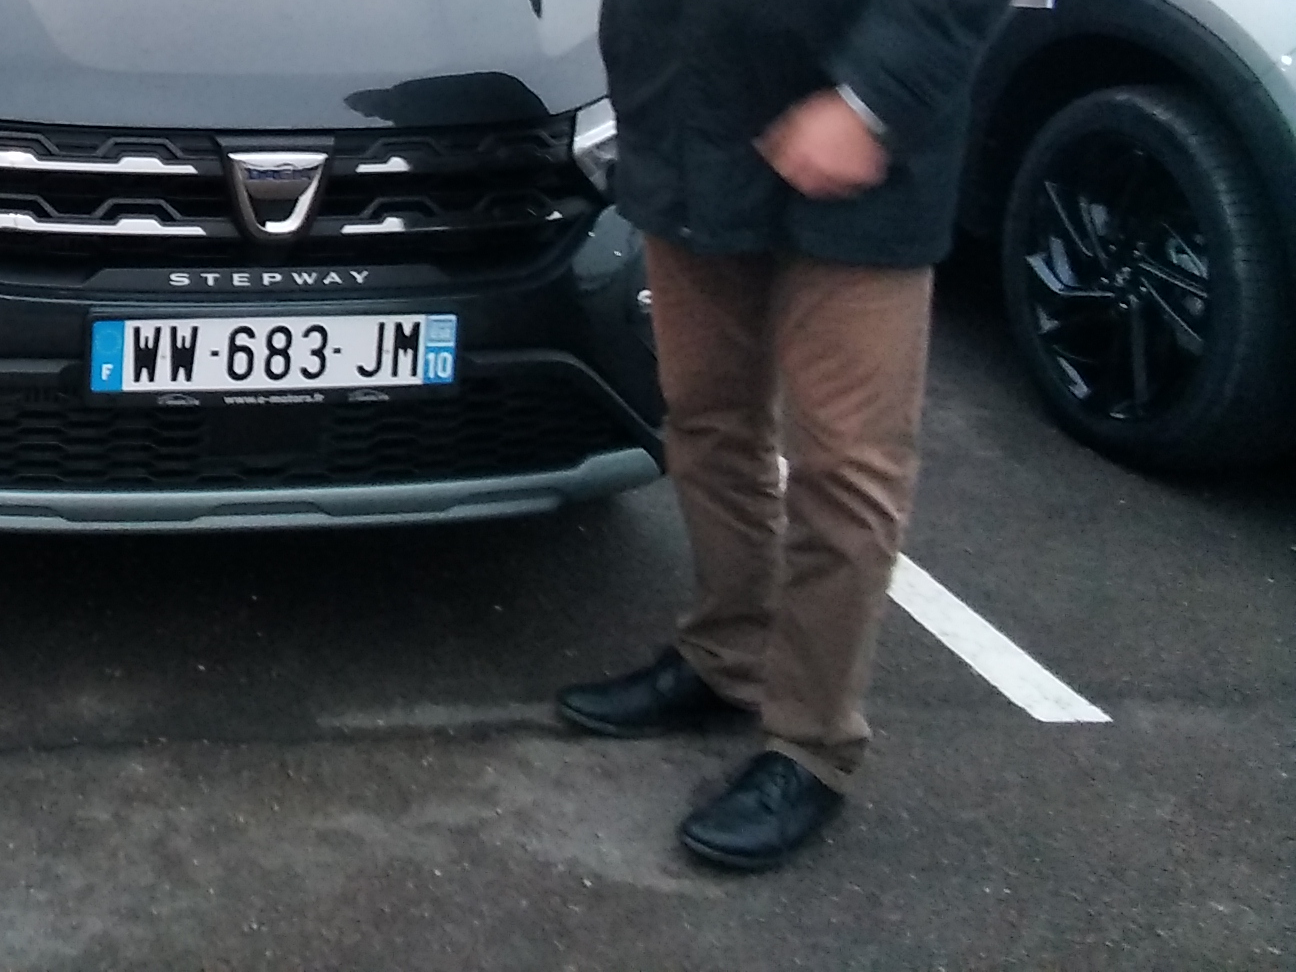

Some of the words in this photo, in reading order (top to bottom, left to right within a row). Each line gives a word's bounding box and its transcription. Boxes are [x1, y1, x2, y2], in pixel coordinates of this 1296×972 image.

[168, 270, 369, 287] STEPWAY
[101, 364, 114, 381] F
[426, 351, 453, 379] 10
